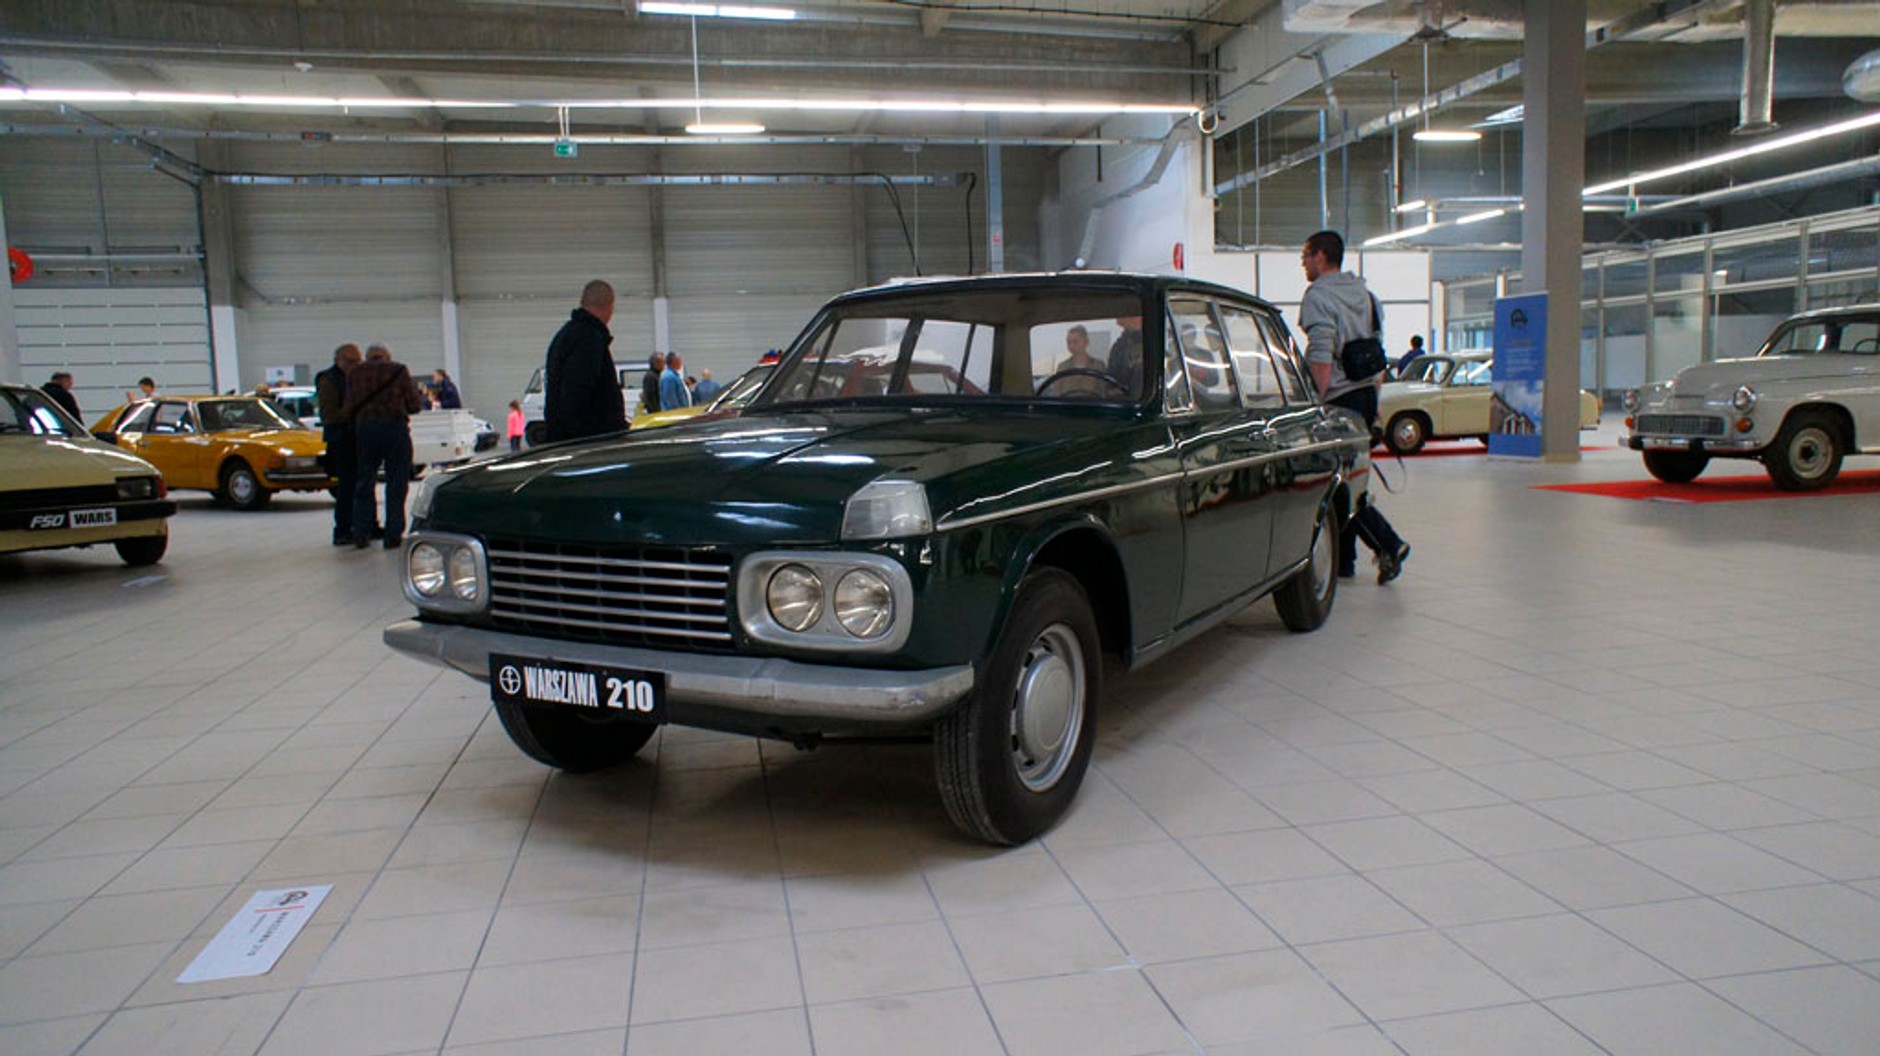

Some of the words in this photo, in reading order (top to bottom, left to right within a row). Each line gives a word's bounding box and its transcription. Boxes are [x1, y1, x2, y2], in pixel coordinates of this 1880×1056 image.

[29, 513, 66, 529] FSO
[73, 510, 115, 526] WARS
[523, 665, 599, 708] WARSZAWA
[605, 677, 655, 712] 210
